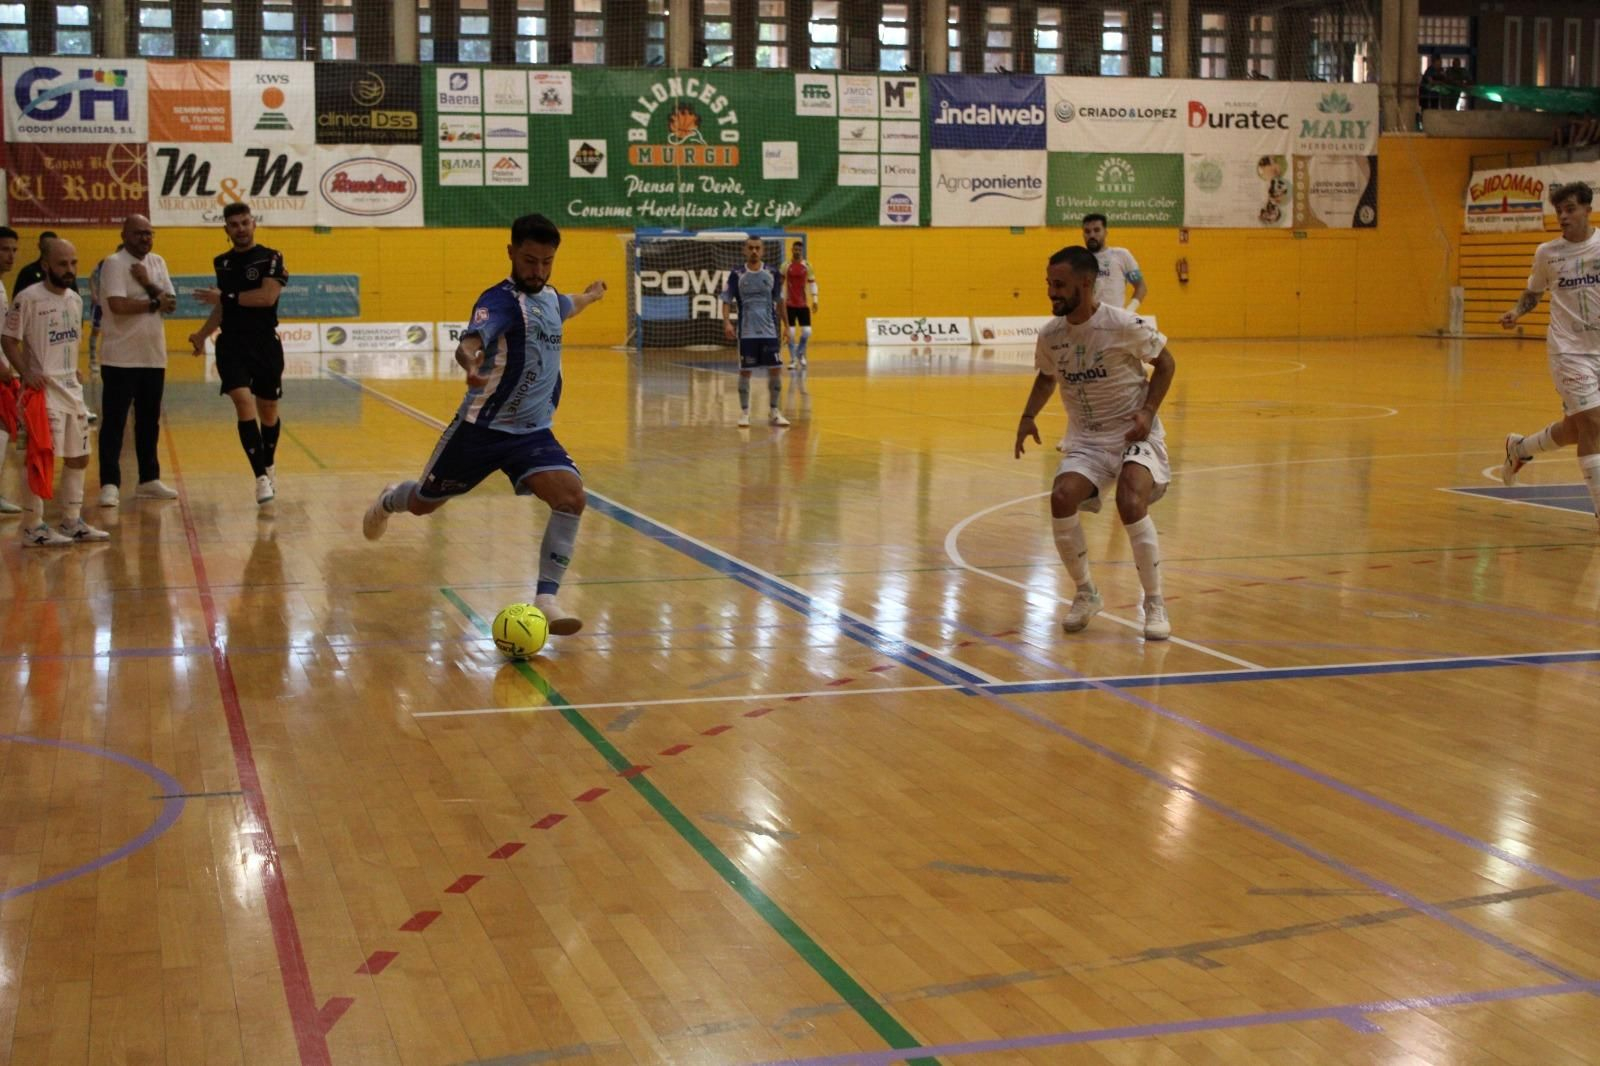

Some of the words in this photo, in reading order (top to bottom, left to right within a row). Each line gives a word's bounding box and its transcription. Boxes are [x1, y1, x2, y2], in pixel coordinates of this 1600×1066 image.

[256, 74, 289, 85] KWS
[15, 67, 129, 121] GH
[440, 93, 480, 105] Baena
[628, 77, 739, 142] BALONCESTO
[935, 101, 1045, 126] indalweb
[1188, 101, 1290, 130] Duratec
[18, 125, 53, 134] GODOY
[57, 125, 117, 135] HORTALIZAS,
[1299, 119, 1371, 139] MARY
[638, 148, 734, 165] MURGI
[624, 176, 675, 197] Piensa
[679, 181, 694, 193] en
[698, 175, 745, 195] Verde,
[937, 174, 1042, 193] Agroponiente
[1470, 174, 1543, 202] EJIDOMAR
[568, 200, 632, 217] Consume
[637, 201, 719, 217] Hortalizas
[723, 201, 737, 217] de
[742, 201, 760, 217] El
[764, 201, 802, 222] Ejido
